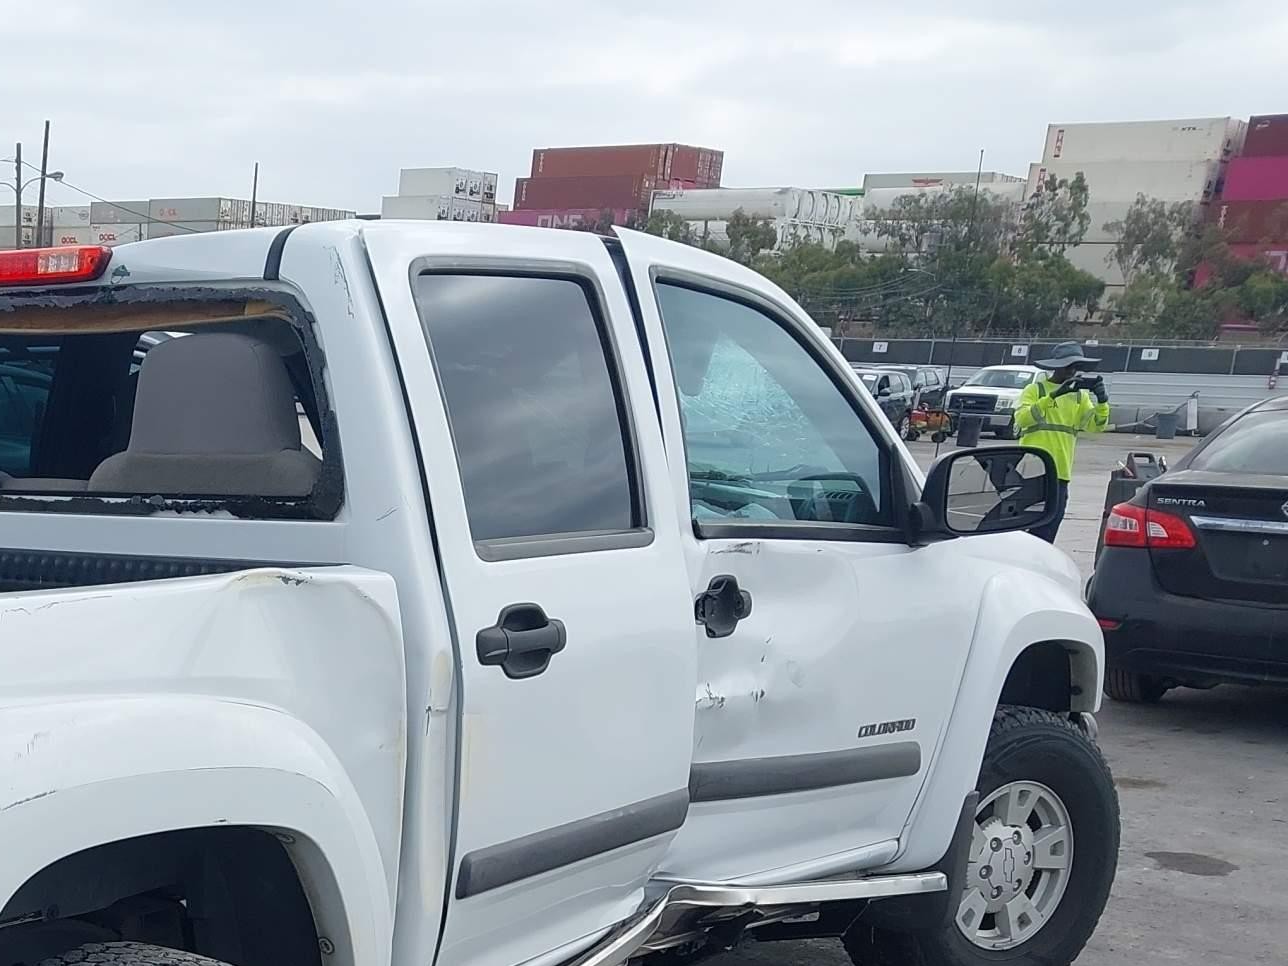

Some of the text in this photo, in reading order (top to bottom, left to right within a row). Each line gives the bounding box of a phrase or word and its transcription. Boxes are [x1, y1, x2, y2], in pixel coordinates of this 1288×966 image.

[61, 236, 79, 244] OOCL
[99, 233, 117, 242] OOCL
[1156, 496, 1207, 507] SENTRA
[857, 718, 917, 738] COLORADO
